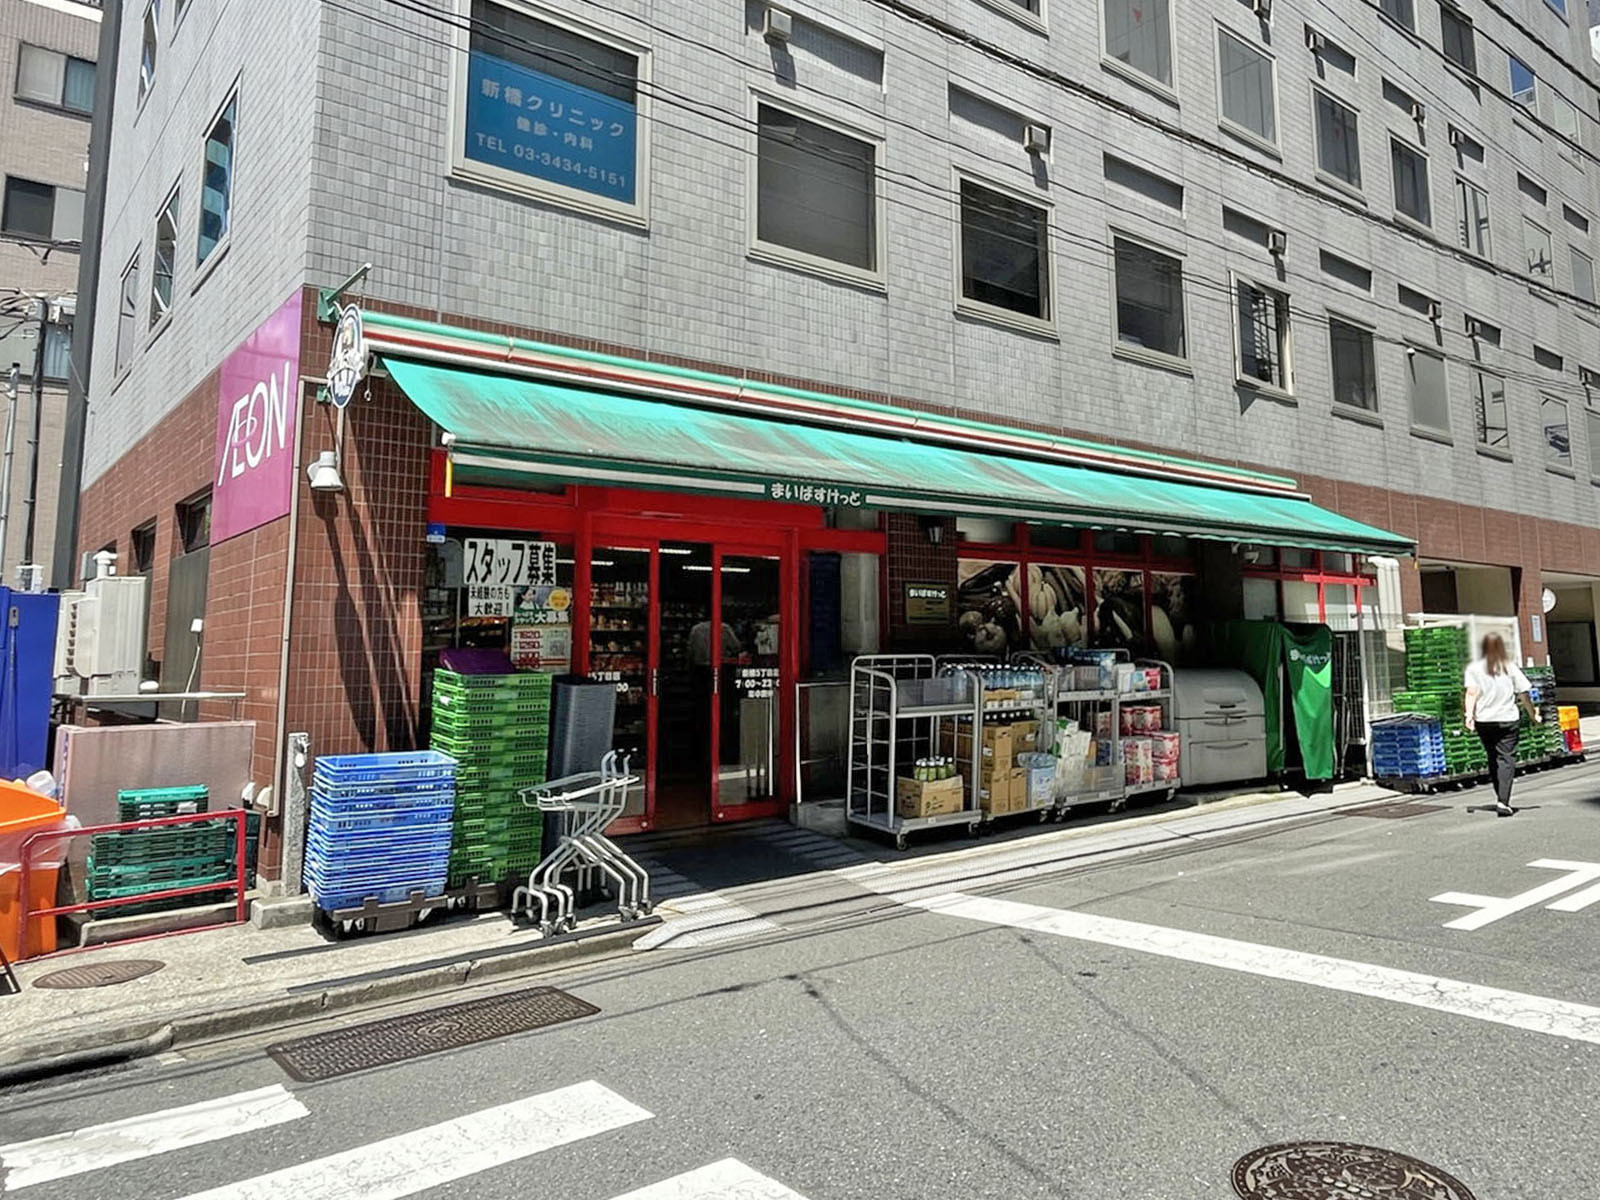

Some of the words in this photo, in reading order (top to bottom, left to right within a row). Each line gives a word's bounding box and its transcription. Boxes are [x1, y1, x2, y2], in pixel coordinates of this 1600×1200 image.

[481, 78, 624, 136] 新橋クリニック
[476, 133, 507, 153] TEL
[771, 482, 861, 506] まいばすけっと
[466, 541, 554, 585] スタッフ募集
